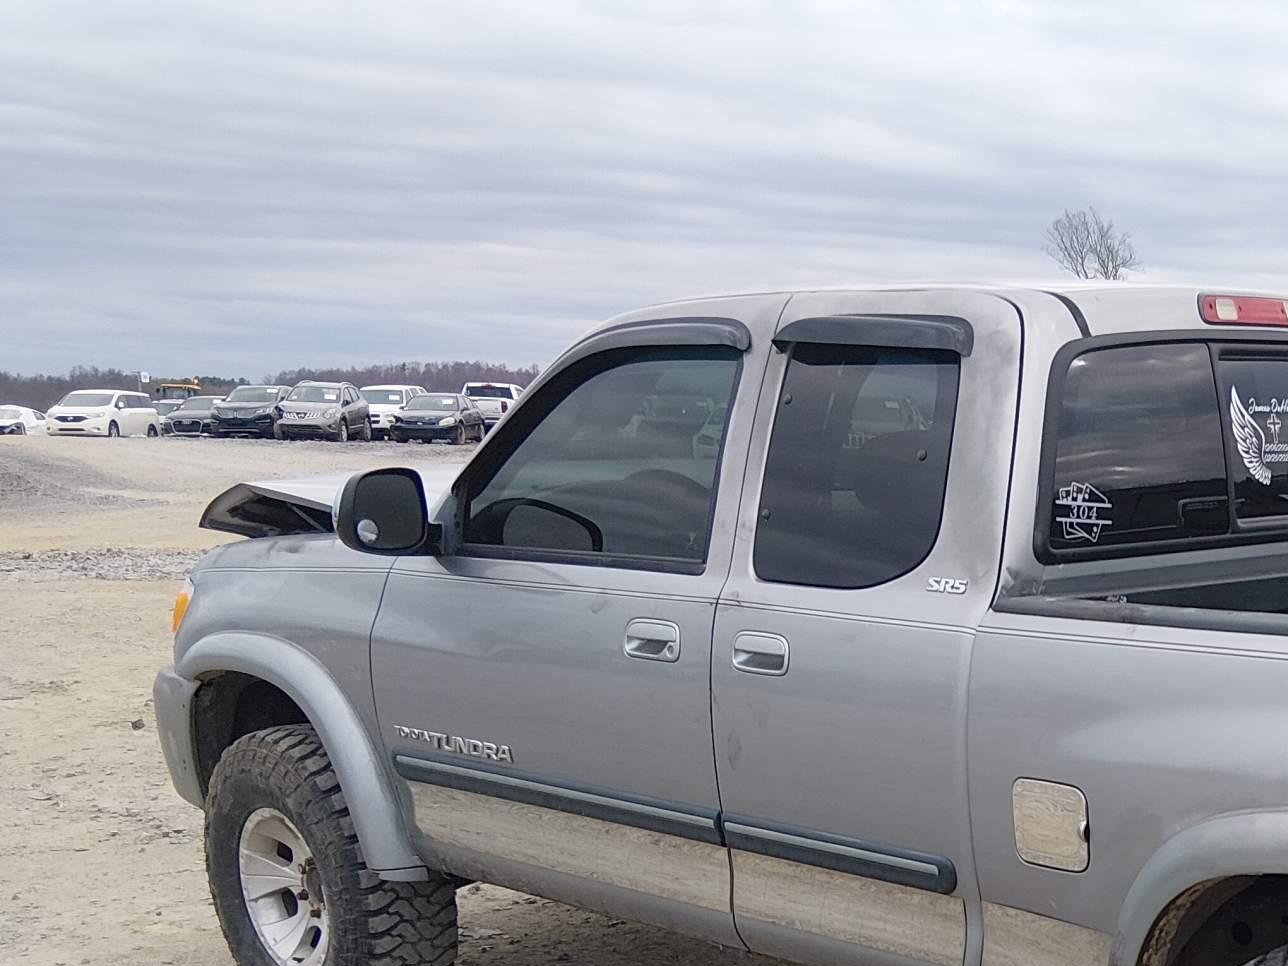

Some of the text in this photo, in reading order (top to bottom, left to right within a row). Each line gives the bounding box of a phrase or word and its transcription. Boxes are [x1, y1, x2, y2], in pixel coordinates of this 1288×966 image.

[1069, 504, 1098, 520] 304
[926, 576, 968, 595] SR5
[429, 731, 514, 763] TUNDRA
